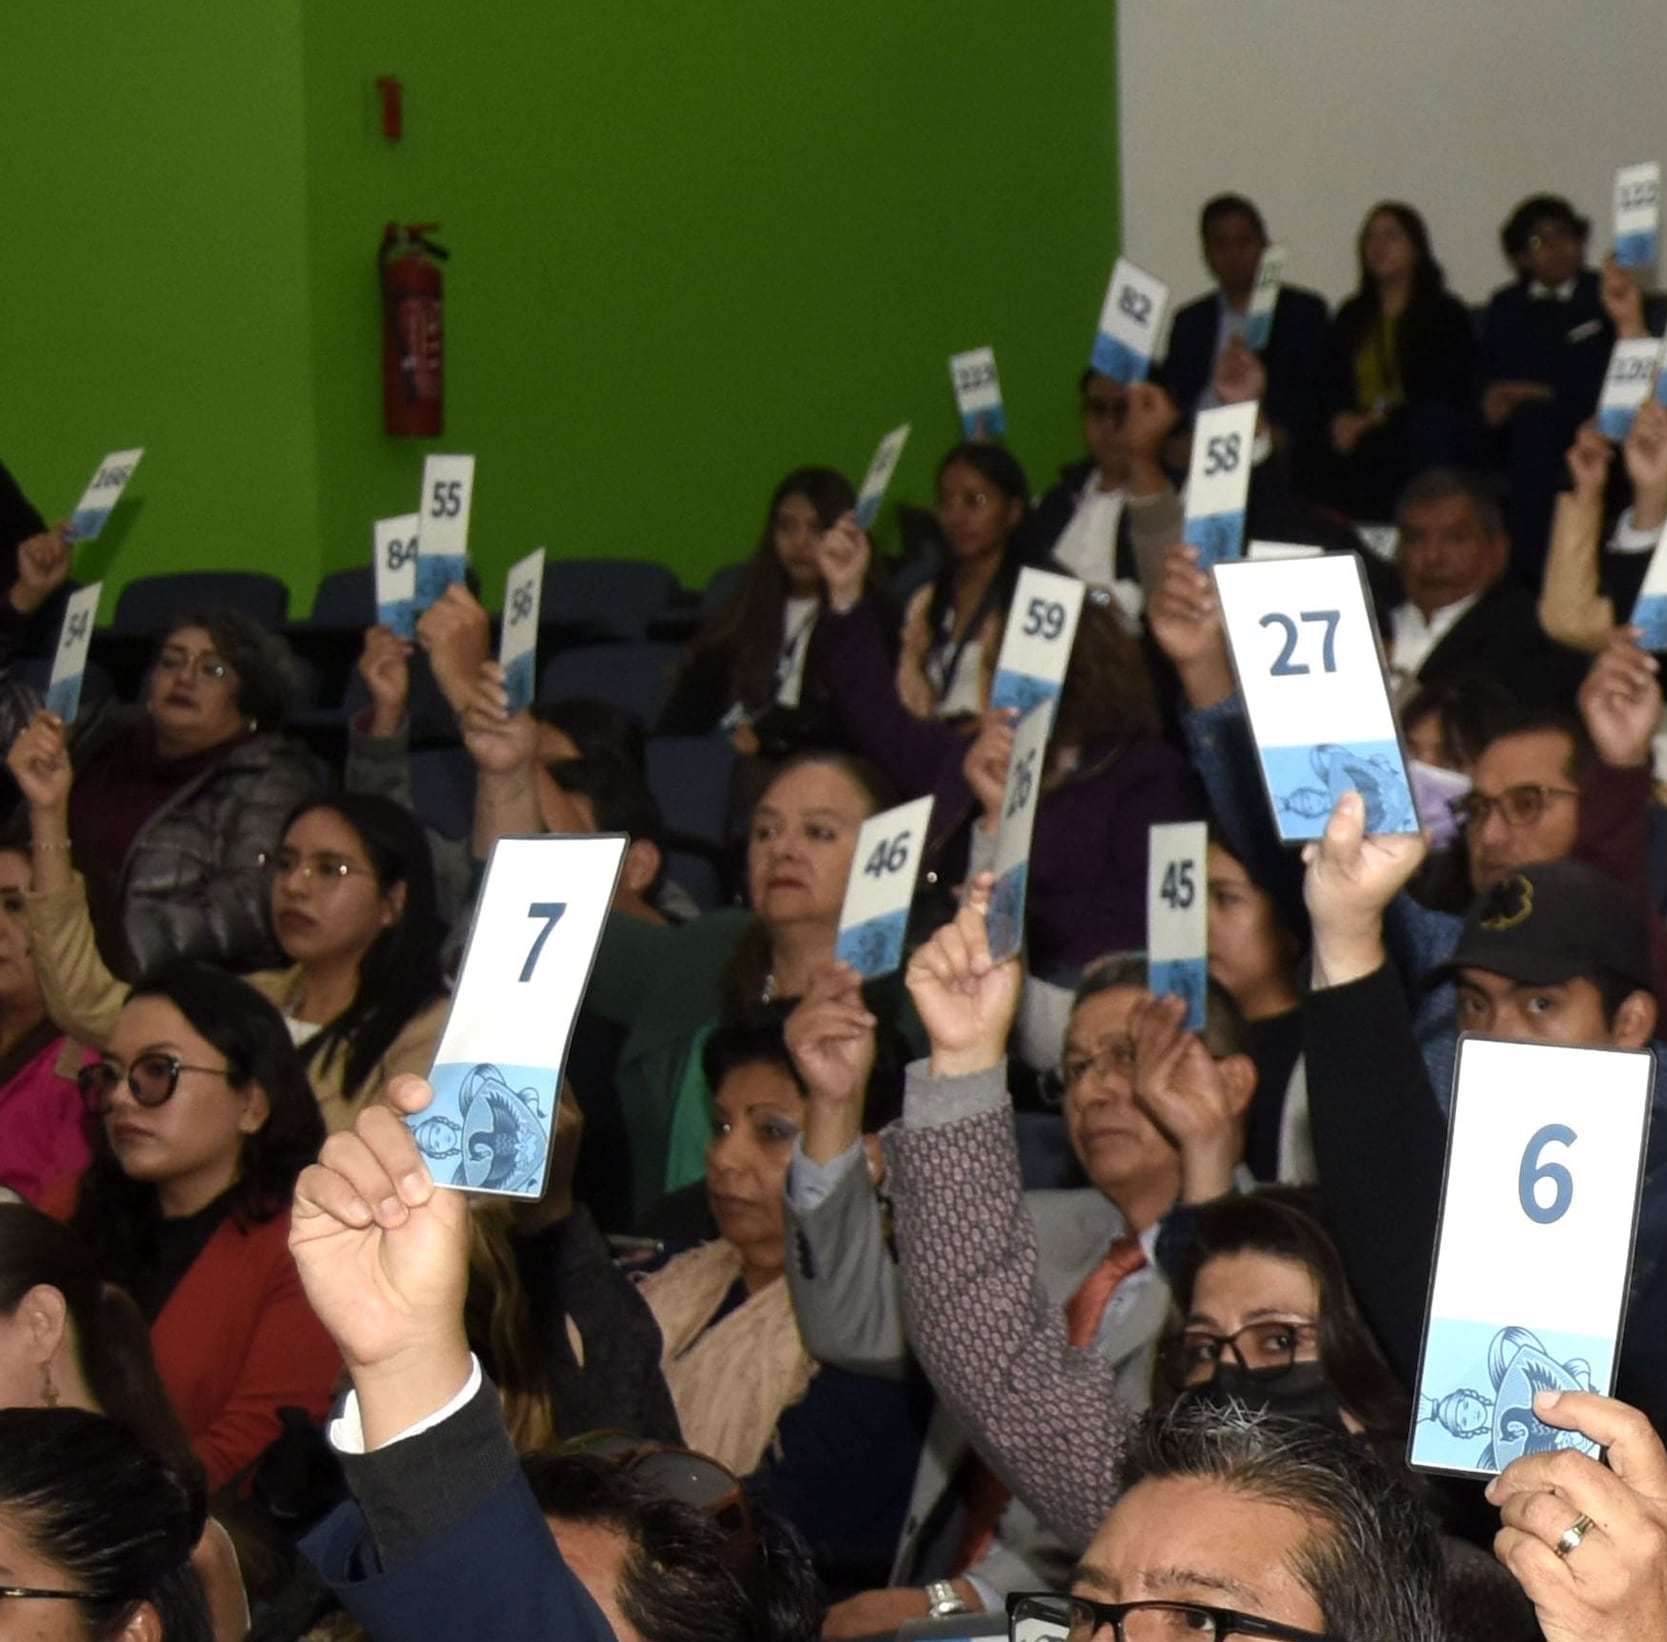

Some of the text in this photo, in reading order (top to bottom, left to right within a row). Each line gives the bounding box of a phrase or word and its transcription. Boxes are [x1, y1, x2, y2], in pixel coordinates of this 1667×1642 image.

[1118, 284, 1151, 324] 82
[1203, 434, 1241, 475] 58
[432, 482, 461, 518] 55
[1021, 599, 1066, 639] 59
[1258, 610, 1342, 676] 27
[864, 832, 908, 878] 46
[1160, 859, 1195, 909] 45
[518, 902, 567, 983] 7
[1515, 1123, 1579, 1228] 6
